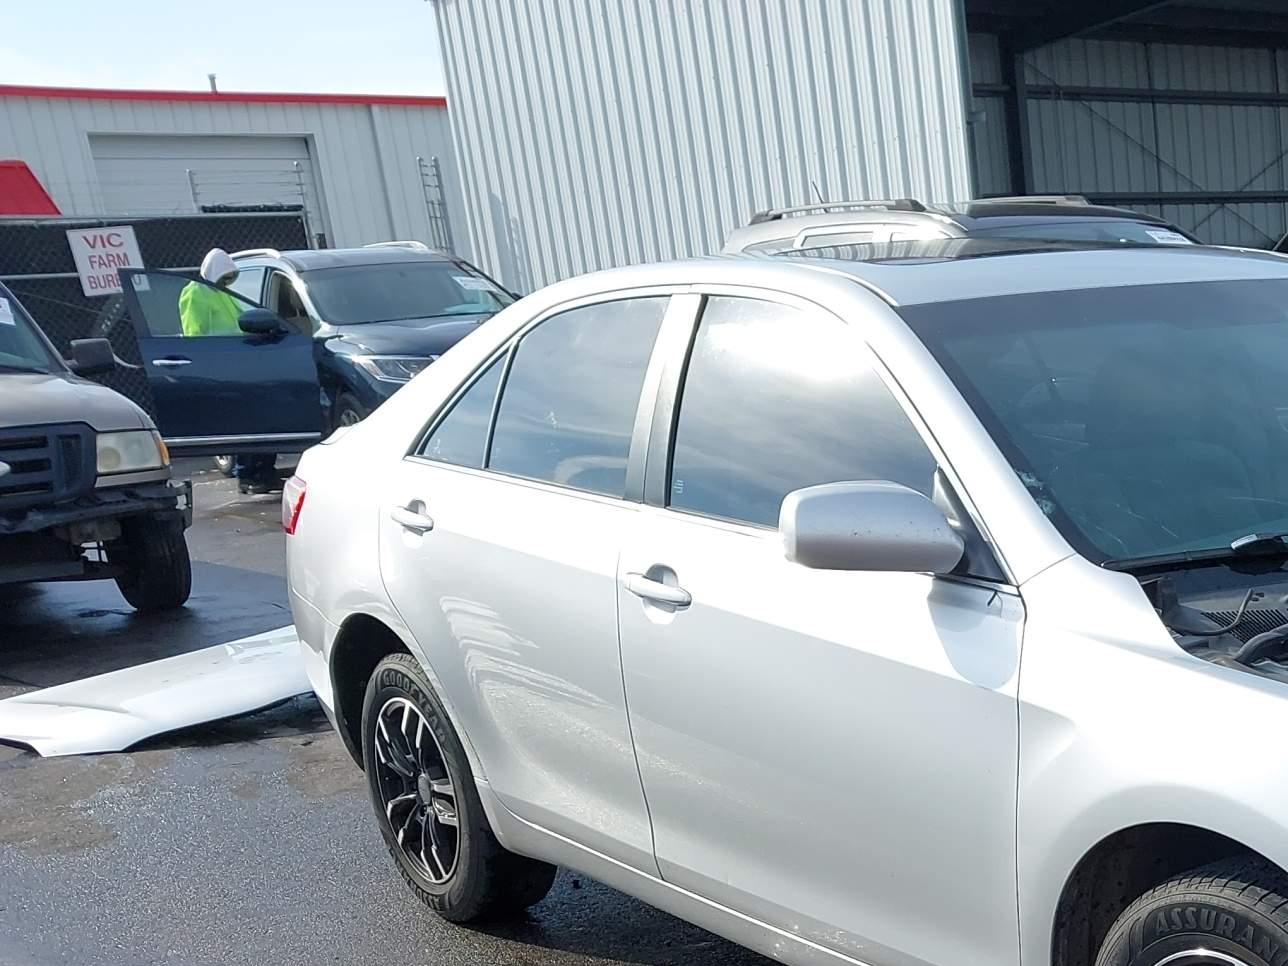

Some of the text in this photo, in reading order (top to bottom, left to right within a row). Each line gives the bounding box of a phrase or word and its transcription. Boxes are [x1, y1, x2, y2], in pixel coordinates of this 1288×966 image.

[82, 233, 124, 249] VIC
[88, 252, 131, 270] FARM
[87, 273, 142, 290] BUREU
